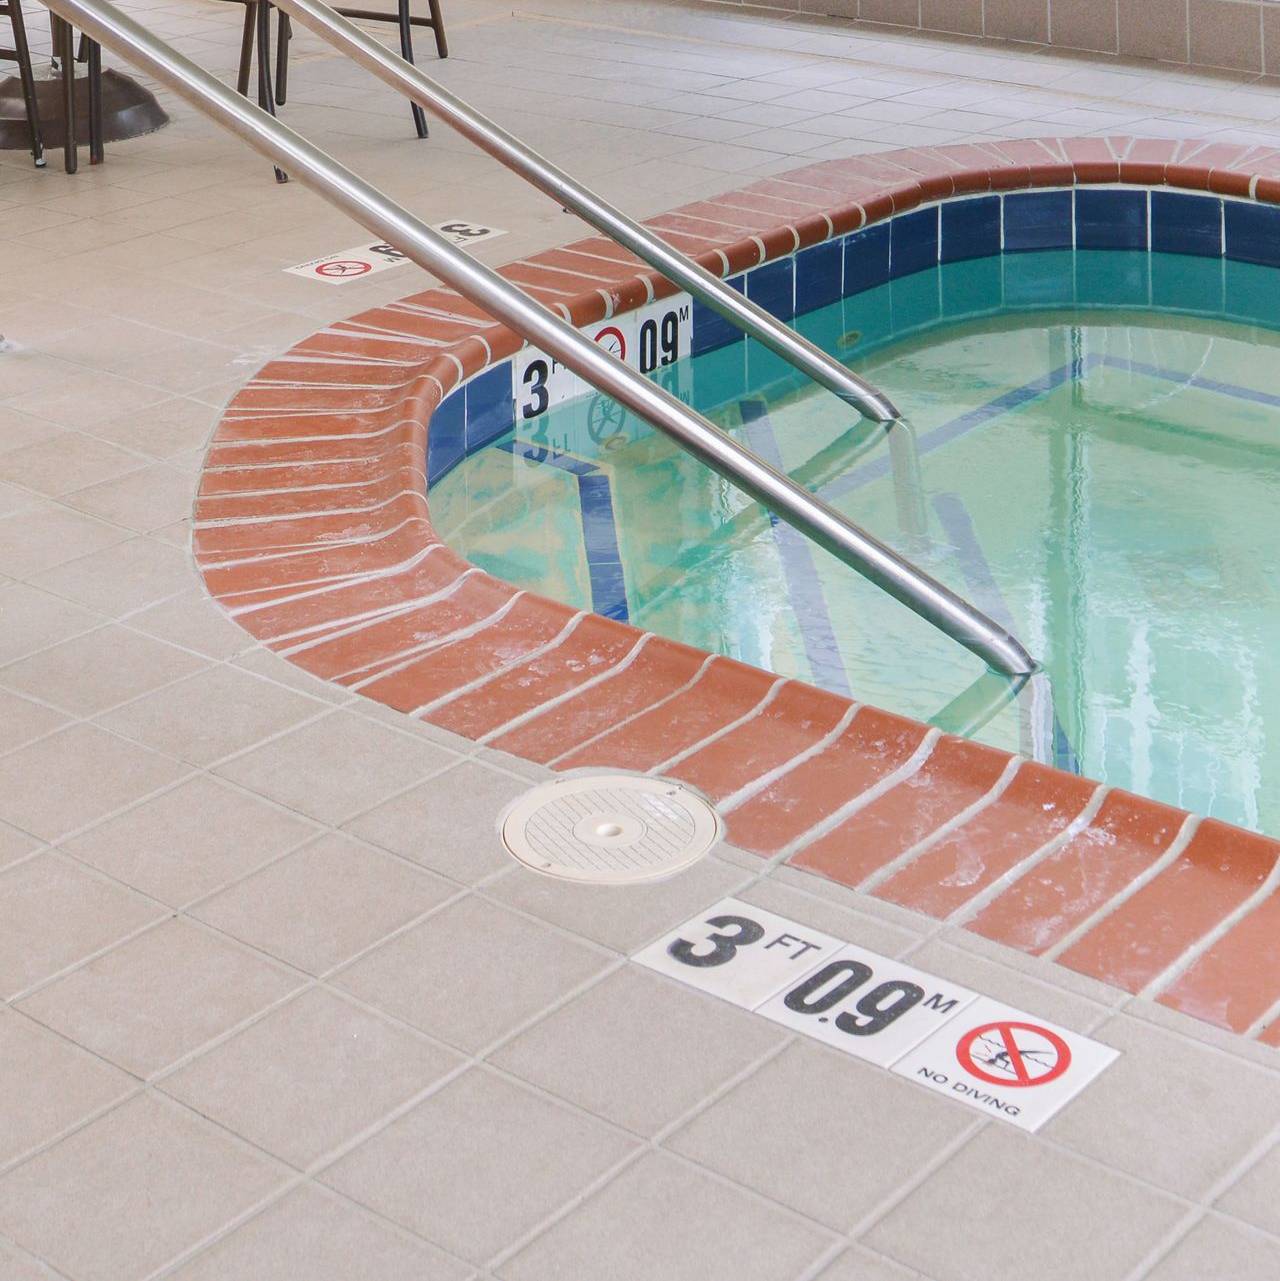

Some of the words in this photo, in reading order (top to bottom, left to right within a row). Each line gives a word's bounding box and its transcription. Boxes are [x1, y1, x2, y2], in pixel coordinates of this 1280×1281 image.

[523, 359, 549, 419] 3
[666, 914, 765, 969] 3
[764, 933, 823, 961] FT
[922, 993, 960, 1016] M
[917, 1066, 950, 1086] NO
[951, 1080, 1023, 1118] DIVING
